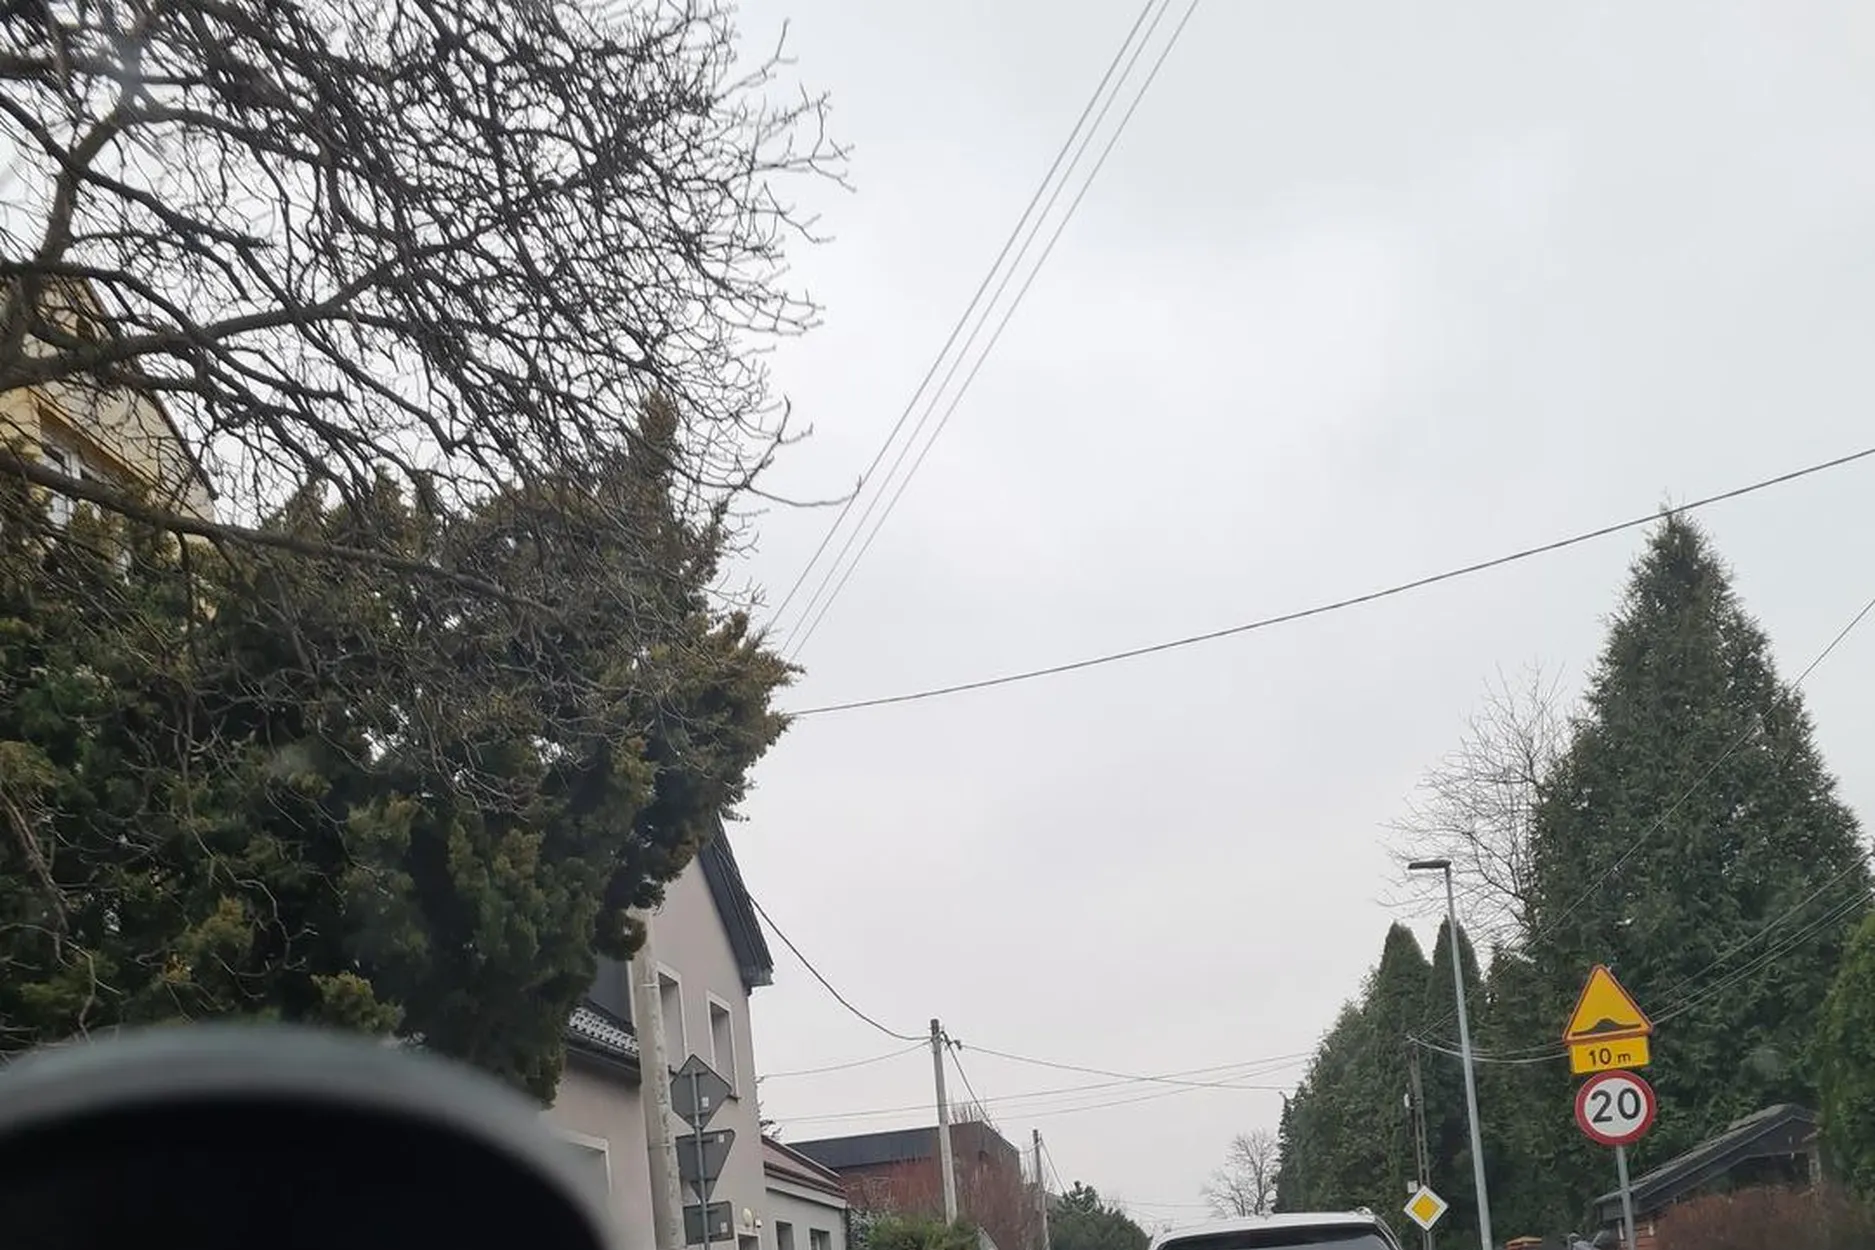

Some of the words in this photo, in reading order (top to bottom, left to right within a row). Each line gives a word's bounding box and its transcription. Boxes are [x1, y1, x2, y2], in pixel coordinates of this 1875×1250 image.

[1589, 1047, 1612, 1066] 10
[1617, 1053, 1631, 1064] m
[1591, 1087, 1641, 1123] 20
